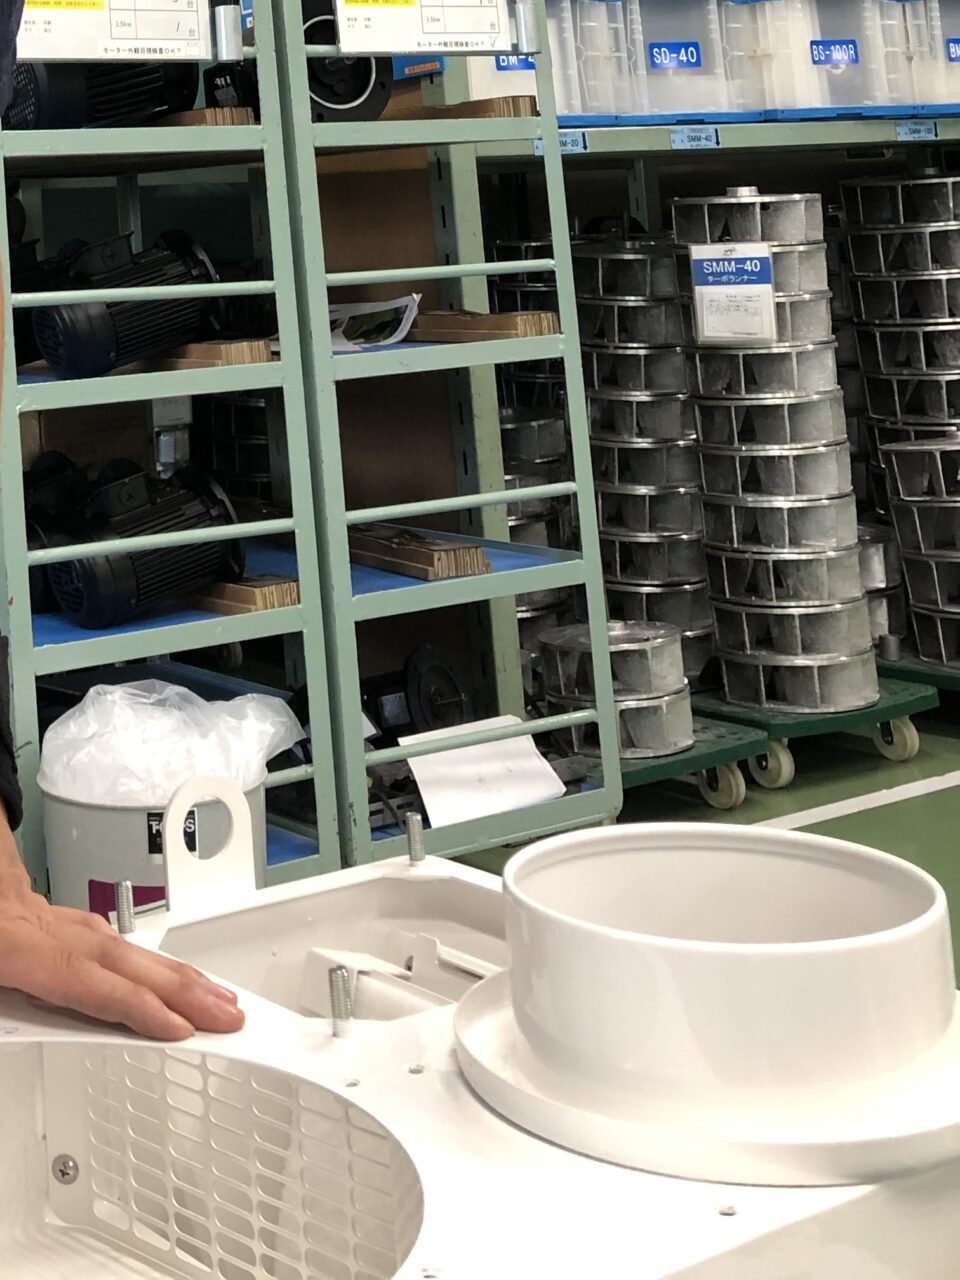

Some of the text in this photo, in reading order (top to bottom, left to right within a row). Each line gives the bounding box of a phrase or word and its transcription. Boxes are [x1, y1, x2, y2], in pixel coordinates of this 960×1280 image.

[187, 0, 194, 9] 台
[188, 28, 196, 37] 台
[653, 47, 697, 64] SD-40
[812, 44, 856, 61] BS-100R
[686, 134, 713, 143] SMM-40
[703, 260, 761, 274] SMM-40
[707, 274, 758, 284] ターボランナー
